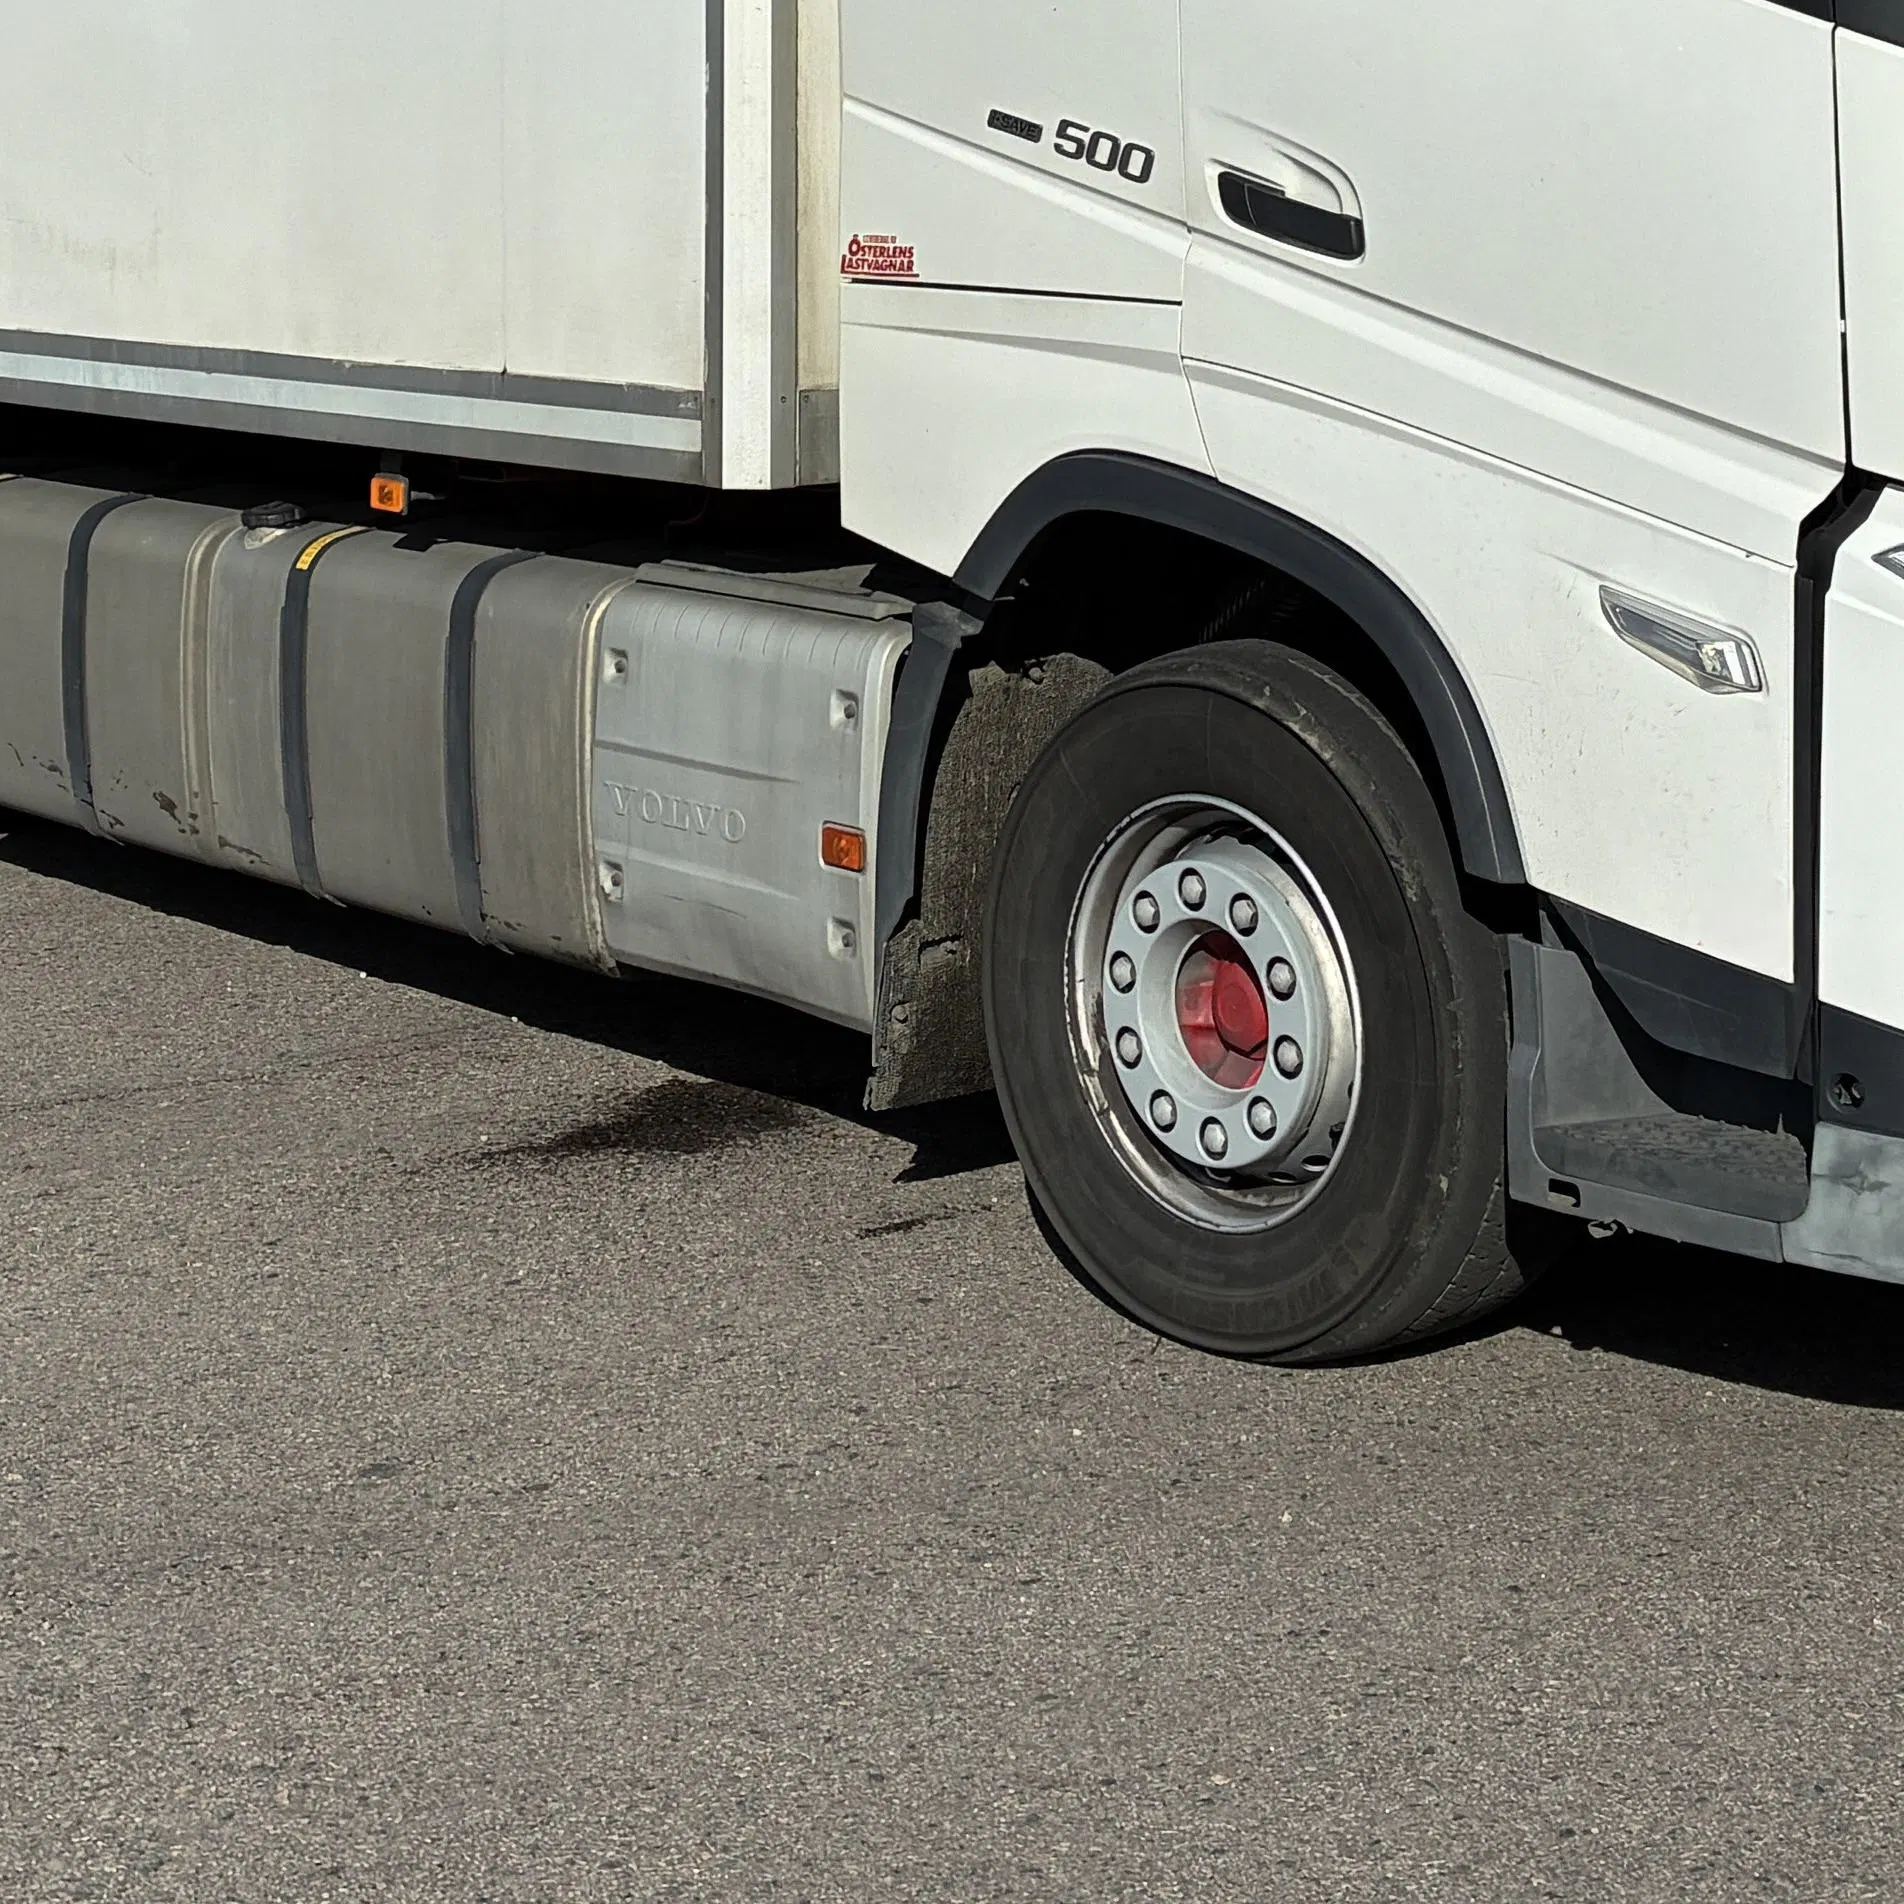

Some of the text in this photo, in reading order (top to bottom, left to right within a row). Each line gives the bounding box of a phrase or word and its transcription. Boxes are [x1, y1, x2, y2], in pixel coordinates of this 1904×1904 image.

[1053, 118, 1155, 184] 500
[840, 254, 918, 277] LASTVAGNAR
[605, 781, 746, 843] VOLVO
